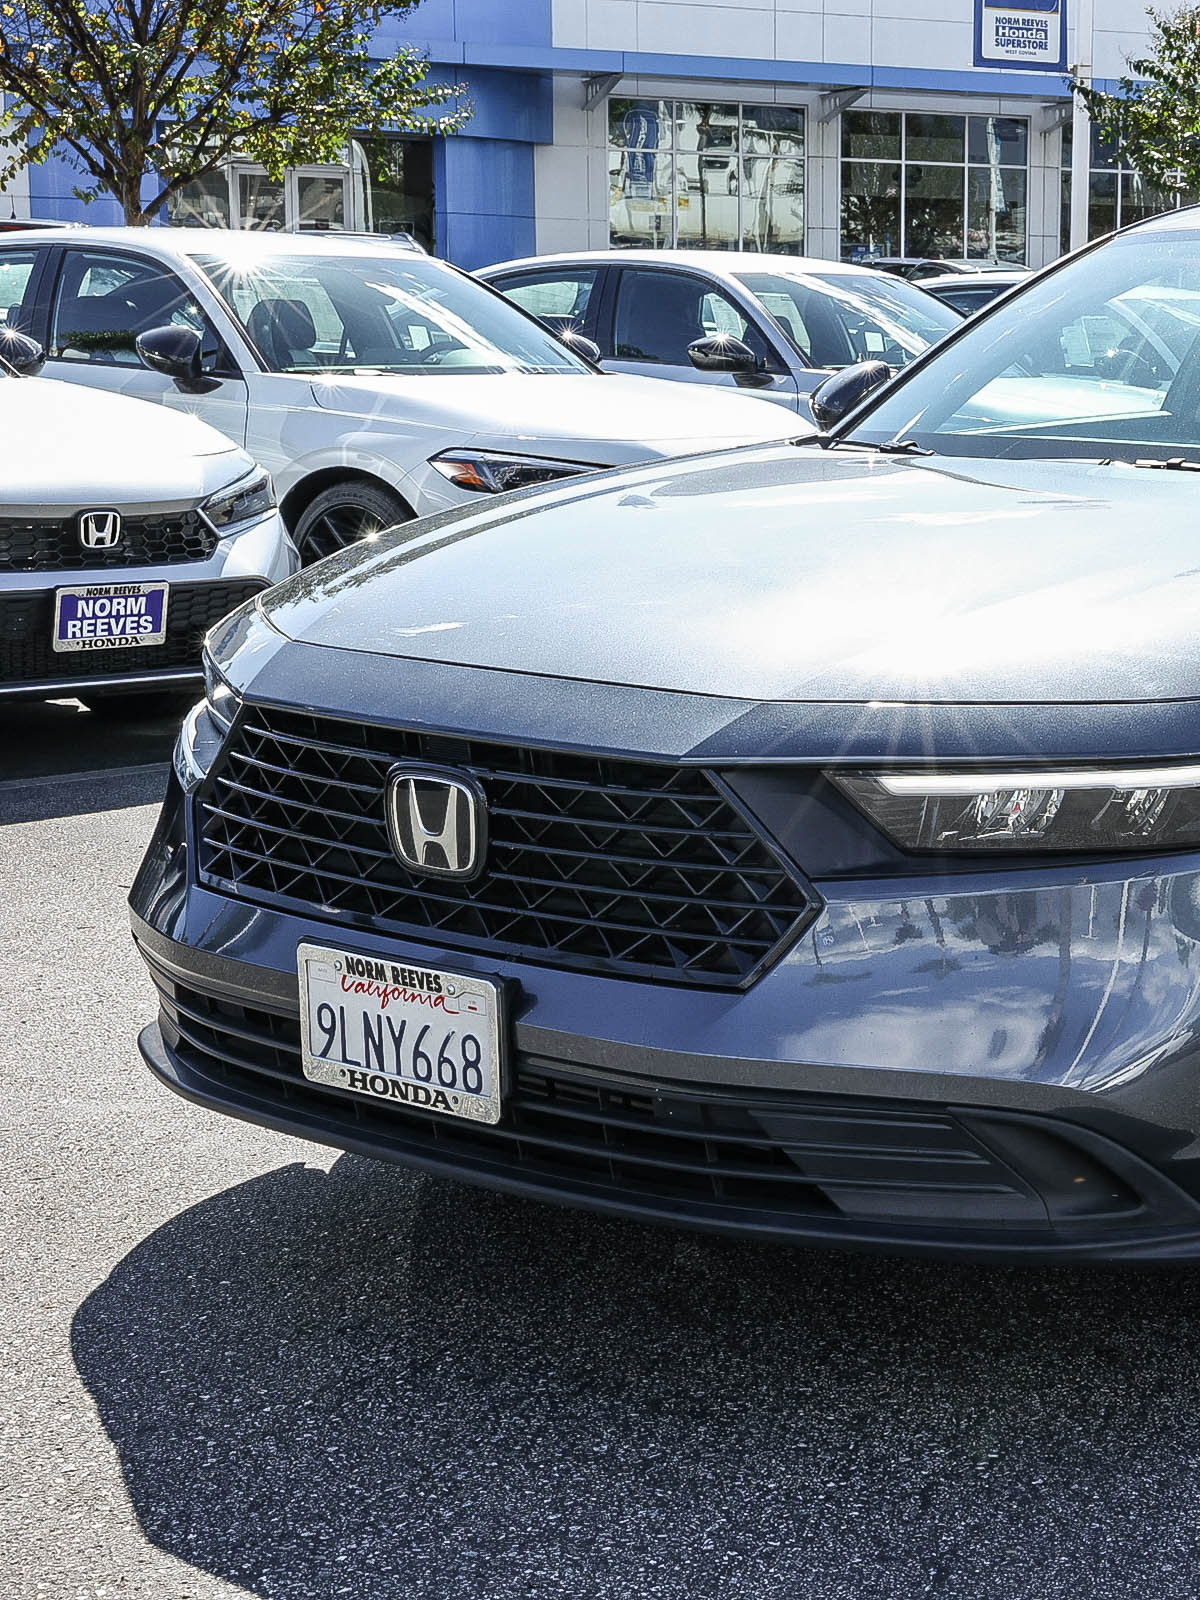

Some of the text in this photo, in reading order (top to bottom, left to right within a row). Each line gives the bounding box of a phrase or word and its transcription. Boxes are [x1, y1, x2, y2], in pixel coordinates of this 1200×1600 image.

[995, 16, 1048, 28] NORM REEVES
[998, 26, 1045, 39] Honda
[995, 38, 1048, 50] SUPERSTORE
[86, 586, 141, 597] NORM REEVES
[77, 597, 146, 618] NORM
[67, 616, 153, 638] REEVES
[81, 636, 140, 649] HONDA
[345, 956, 442, 993] NORM REEVES
[341, 975, 459, 1014] California
[317, 1003, 482, 1094] 9LNY668
[347, 1069, 454, 1112] HONDA
